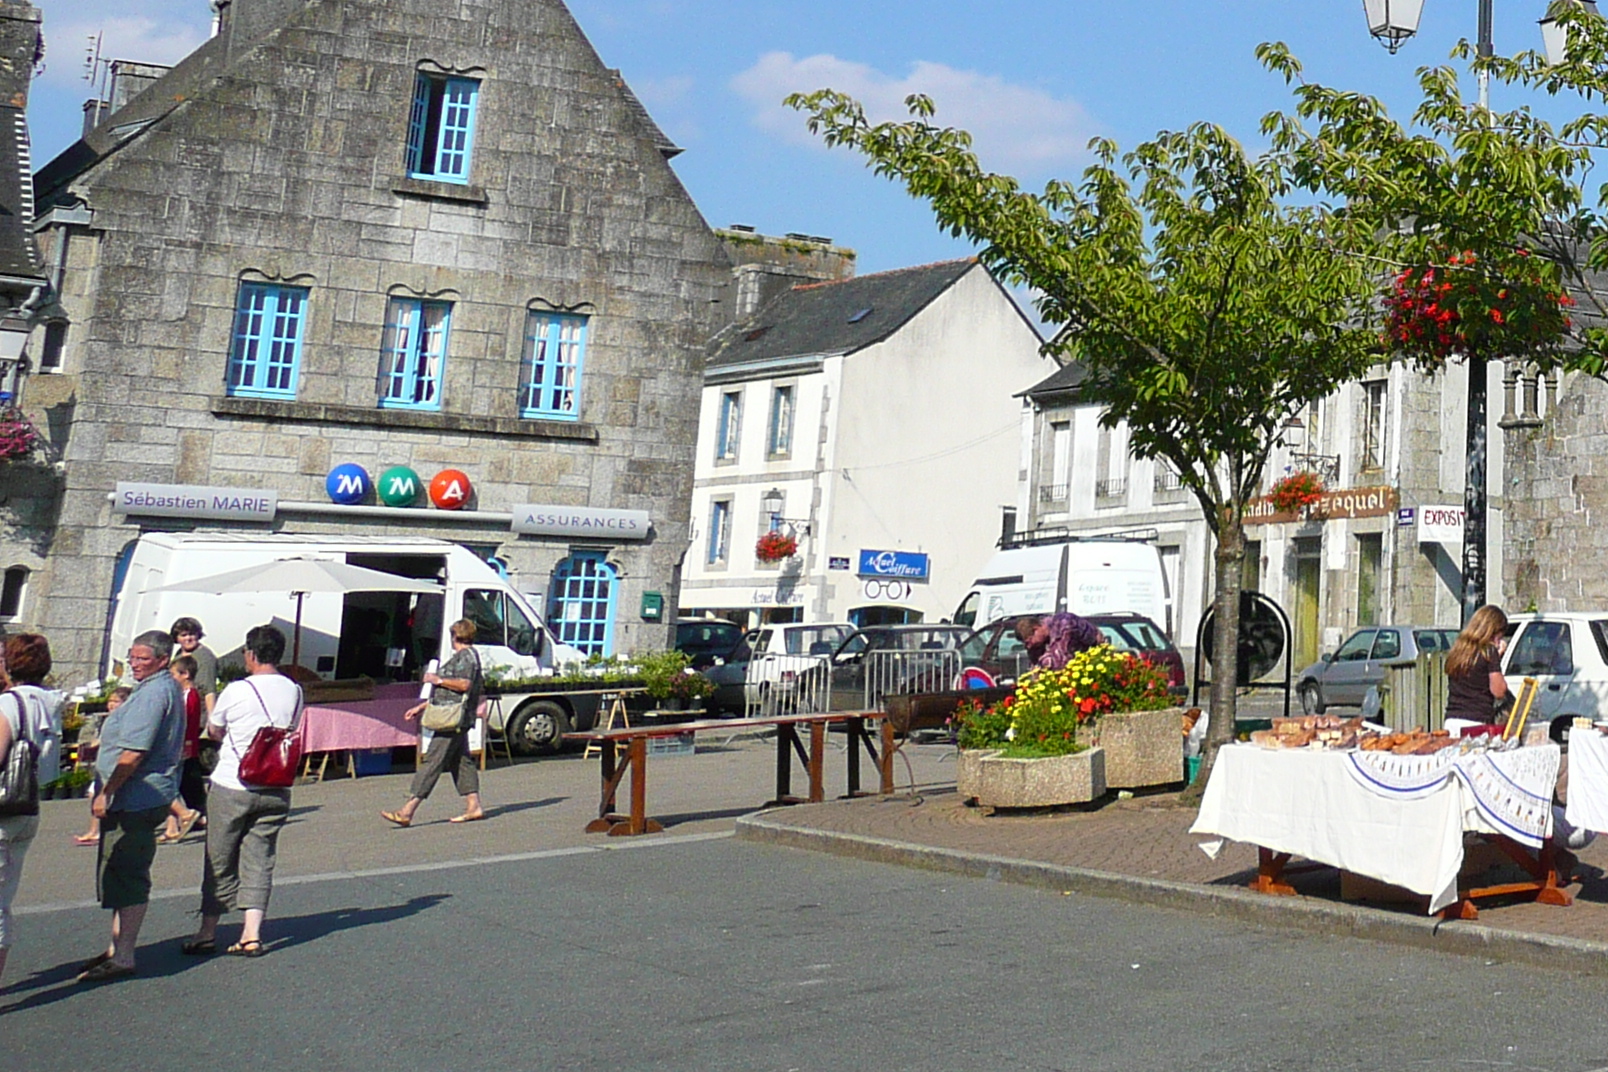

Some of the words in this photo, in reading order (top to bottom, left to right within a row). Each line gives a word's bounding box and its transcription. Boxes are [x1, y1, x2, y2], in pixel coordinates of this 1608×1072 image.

[124, 491, 206, 509] Sébastien
[213, 495, 270, 513] MARIE
[524, 512, 638, 530] ASSURANCES
